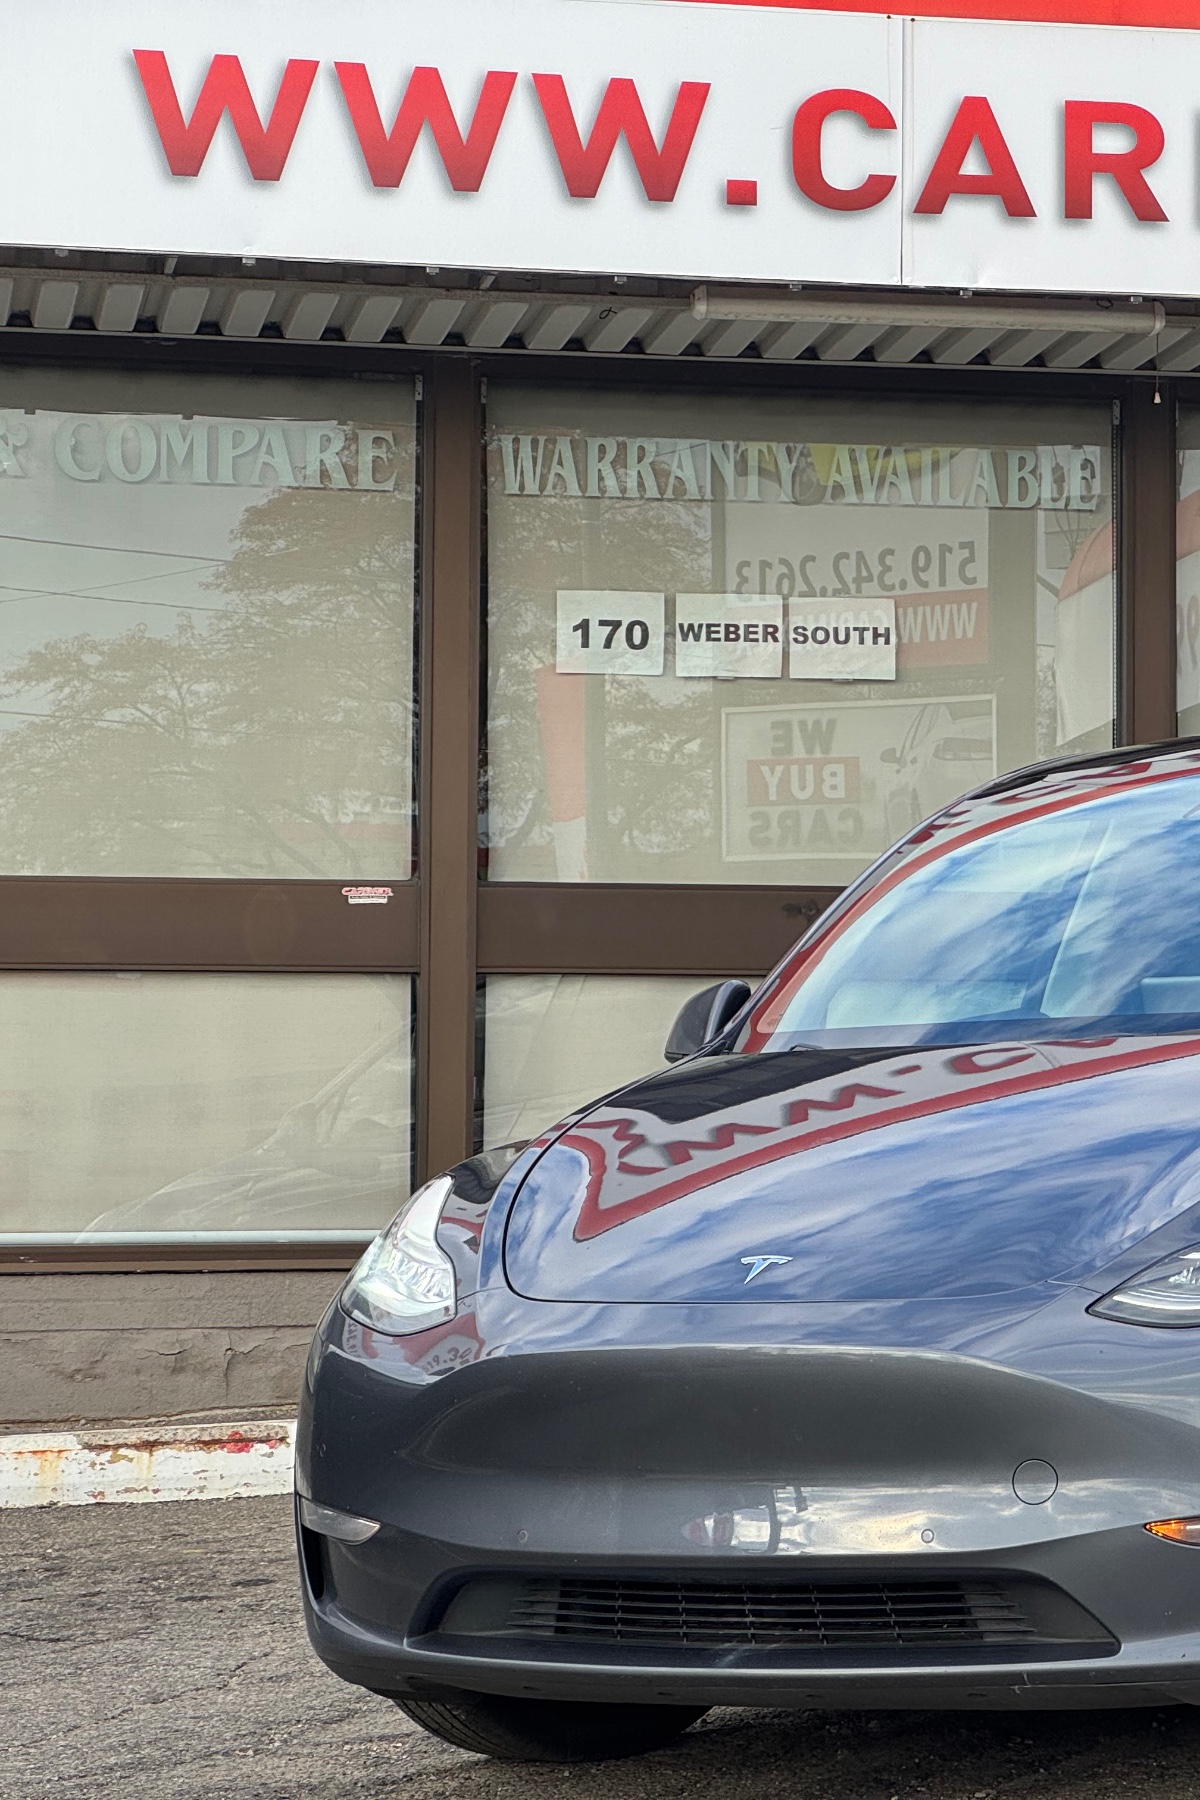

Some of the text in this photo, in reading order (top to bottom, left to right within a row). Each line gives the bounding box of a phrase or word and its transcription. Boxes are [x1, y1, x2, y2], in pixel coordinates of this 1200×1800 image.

[54, 417, 400, 492] COMPARE
[500, 434, 1099, 512] WARRANTY AVAILABLE
[571, 618, 650, 651] 170
[678, 622, 891, 646] WEBER SOUTH
